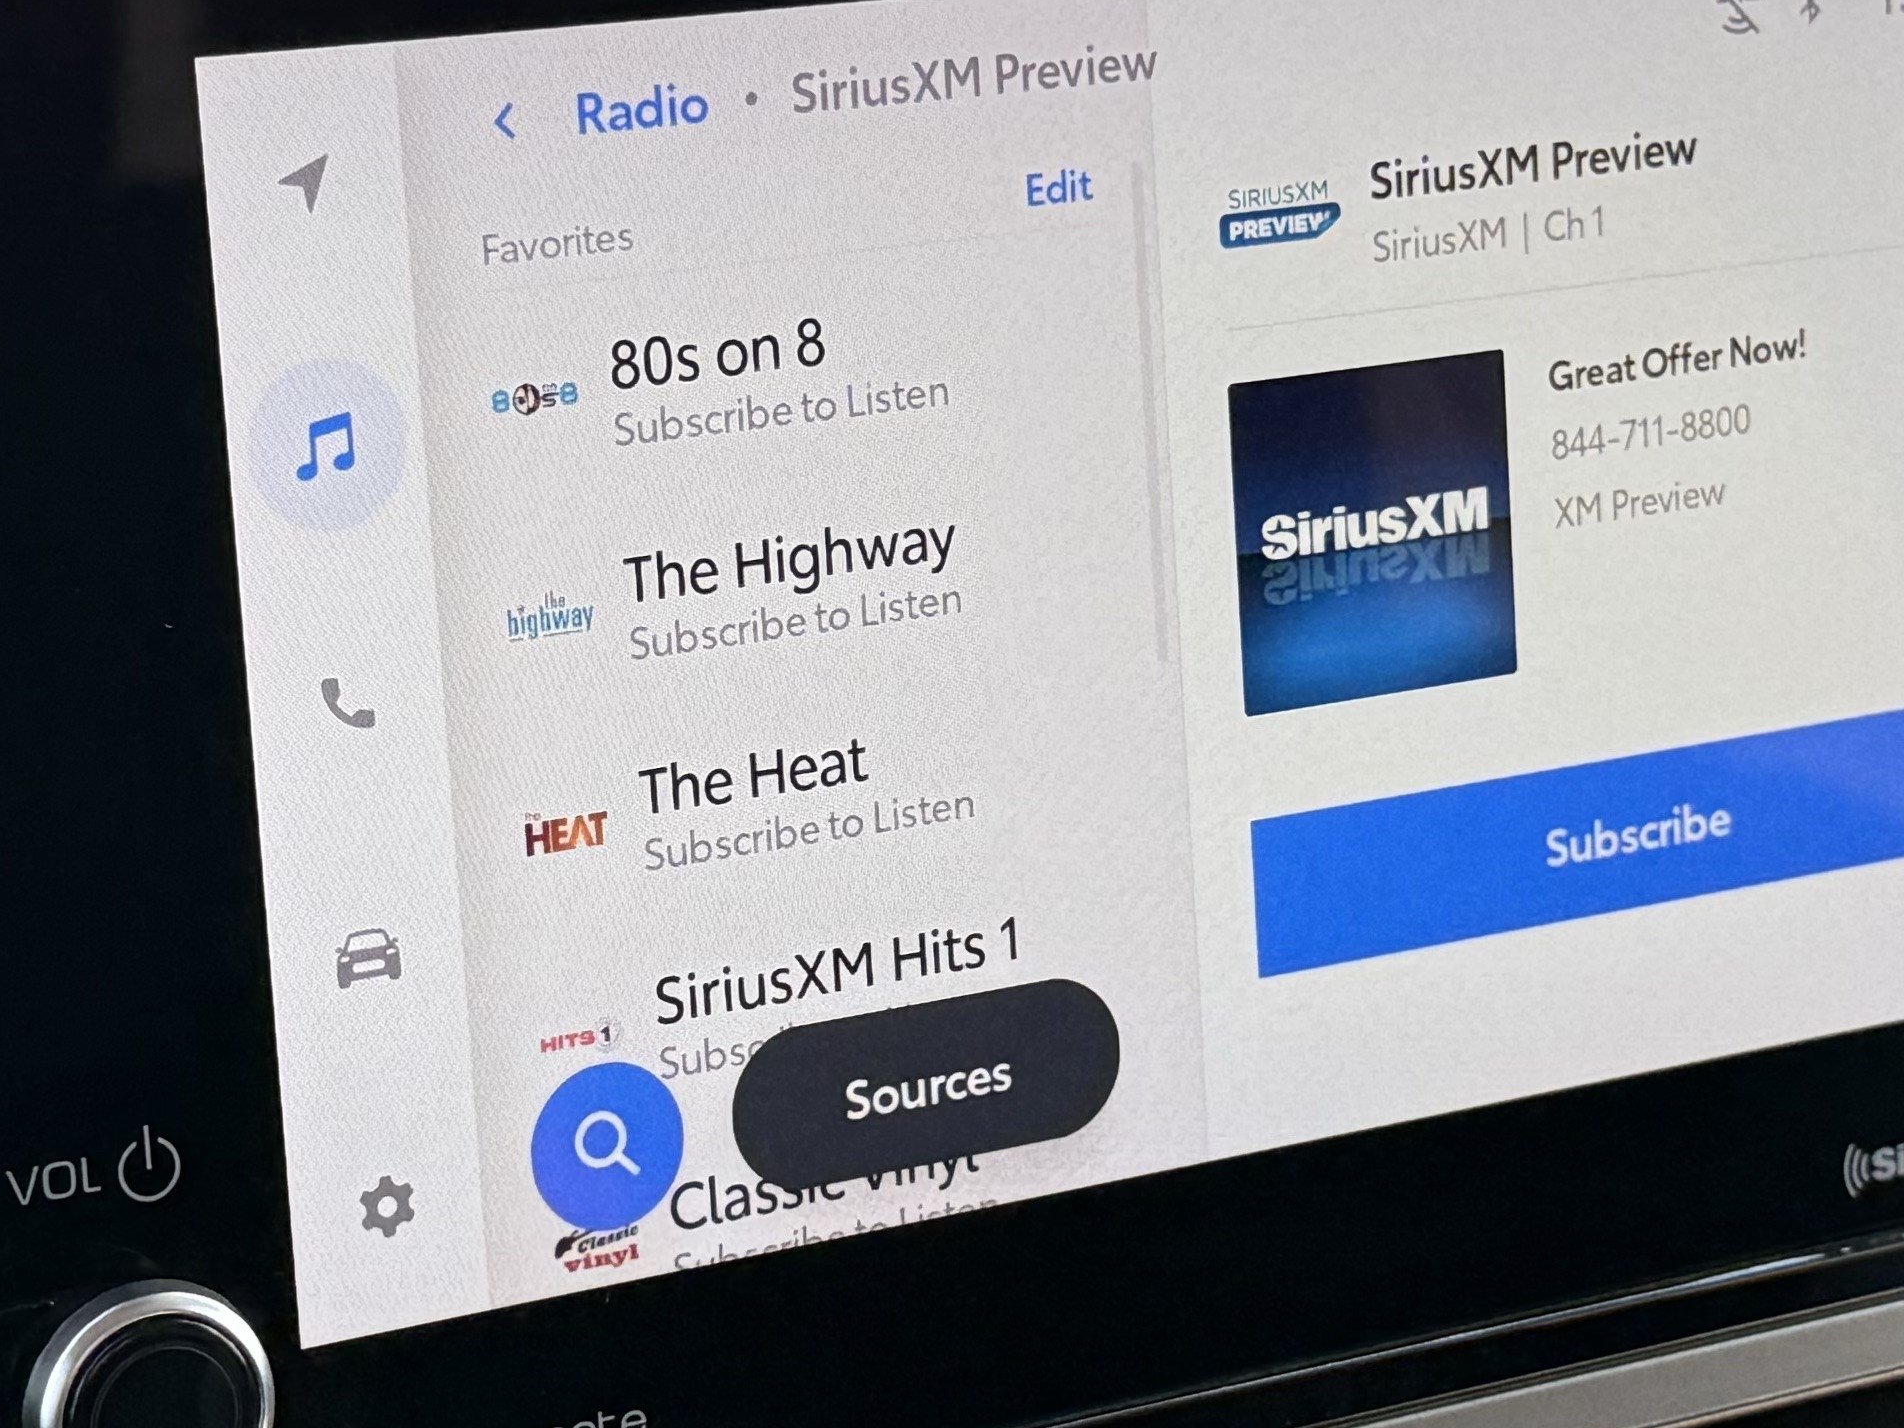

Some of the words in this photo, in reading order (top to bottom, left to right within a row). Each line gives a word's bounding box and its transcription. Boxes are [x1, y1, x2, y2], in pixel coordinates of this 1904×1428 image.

[577, 84, 707, 131] Radio
[792, 56, 979, 111] SiriusXM
[995, 47, 1156, 92] Preview
[1025, 171, 1092, 204] Edit
[1228, 179, 1328, 209] SIRIUSXM
[1370, 144, 1538, 198] SiriusXM
[1551, 131, 1695, 179] Preview
[482, 224, 632, 263] Favorites
[1229, 210, 1331, 241] PREVIEW
[1372, 218, 1505, 262] SiriusXM
[610, 335, 697, 386] 80s
[717, 334, 779, 373] on
[795, 318, 827, 366] 8
[1549, 355, 1635, 390] Great
[1642, 345, 1722, 380] Offer
[1730, 330, 1805, 366] Now!
[613, 398, 790, 443] Subscribe
[801, 395, 836, 424] to
[847, 378, 947, 416] Listen
[1551, 404, 1750, 459] 844-711-8800
[1260, 486, 1488, 557] SiriusXM
[1555, 490, 1602, 530] XM
[1613, 481, 1723, 520] Preview
[623, 551, 716, 601] The
[735, 521, 954, 592] Highway
[506, 605, 593, 639] highway
[629, 606, 805, 657] Subscribe
[814, 603, 851, 631] to
[861, 586, 960, 624] Listen
[639, 762, 732, 812] The
[748, 738, 868, 793] Heat
[525, 811, 608, 857] HEAT
[644, 820, 817, 868] Subscribe
[829, 812, 865, 842] to
[875, 794, 974, 831] Listen
[1546, 803, 1730, 866] Subscribe
[656, 942, 872, 1022] SiriusXM
[894, 929, 984, 978] Hits
[1002, 917, 1021, 960] 1
[846, 1063, 1010, 1117] Sources
[6, 1159, 101, 1206] VOL
